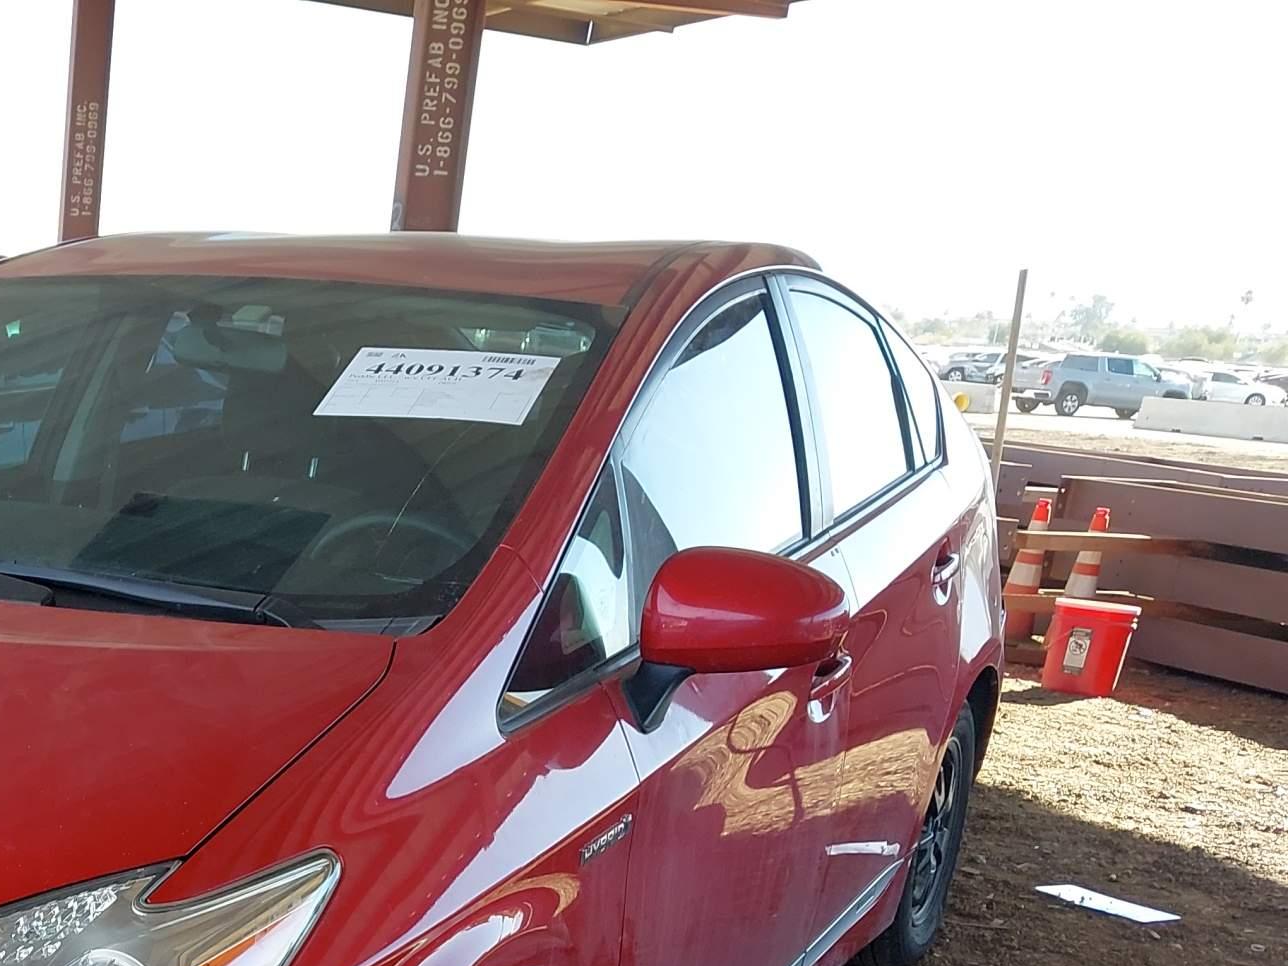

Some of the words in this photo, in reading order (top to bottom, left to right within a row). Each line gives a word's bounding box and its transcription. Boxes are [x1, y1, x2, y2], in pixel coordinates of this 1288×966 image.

[421, 41, 445, 125] PREFAB
[75, 100, 88, 126] INC.
[72, 132, 85, 184] PREFAB
[414, 138, 434, 177] U.S.
[70, 191, 81, 216] U.S.
[365, 362, 525, 381] 44091374
